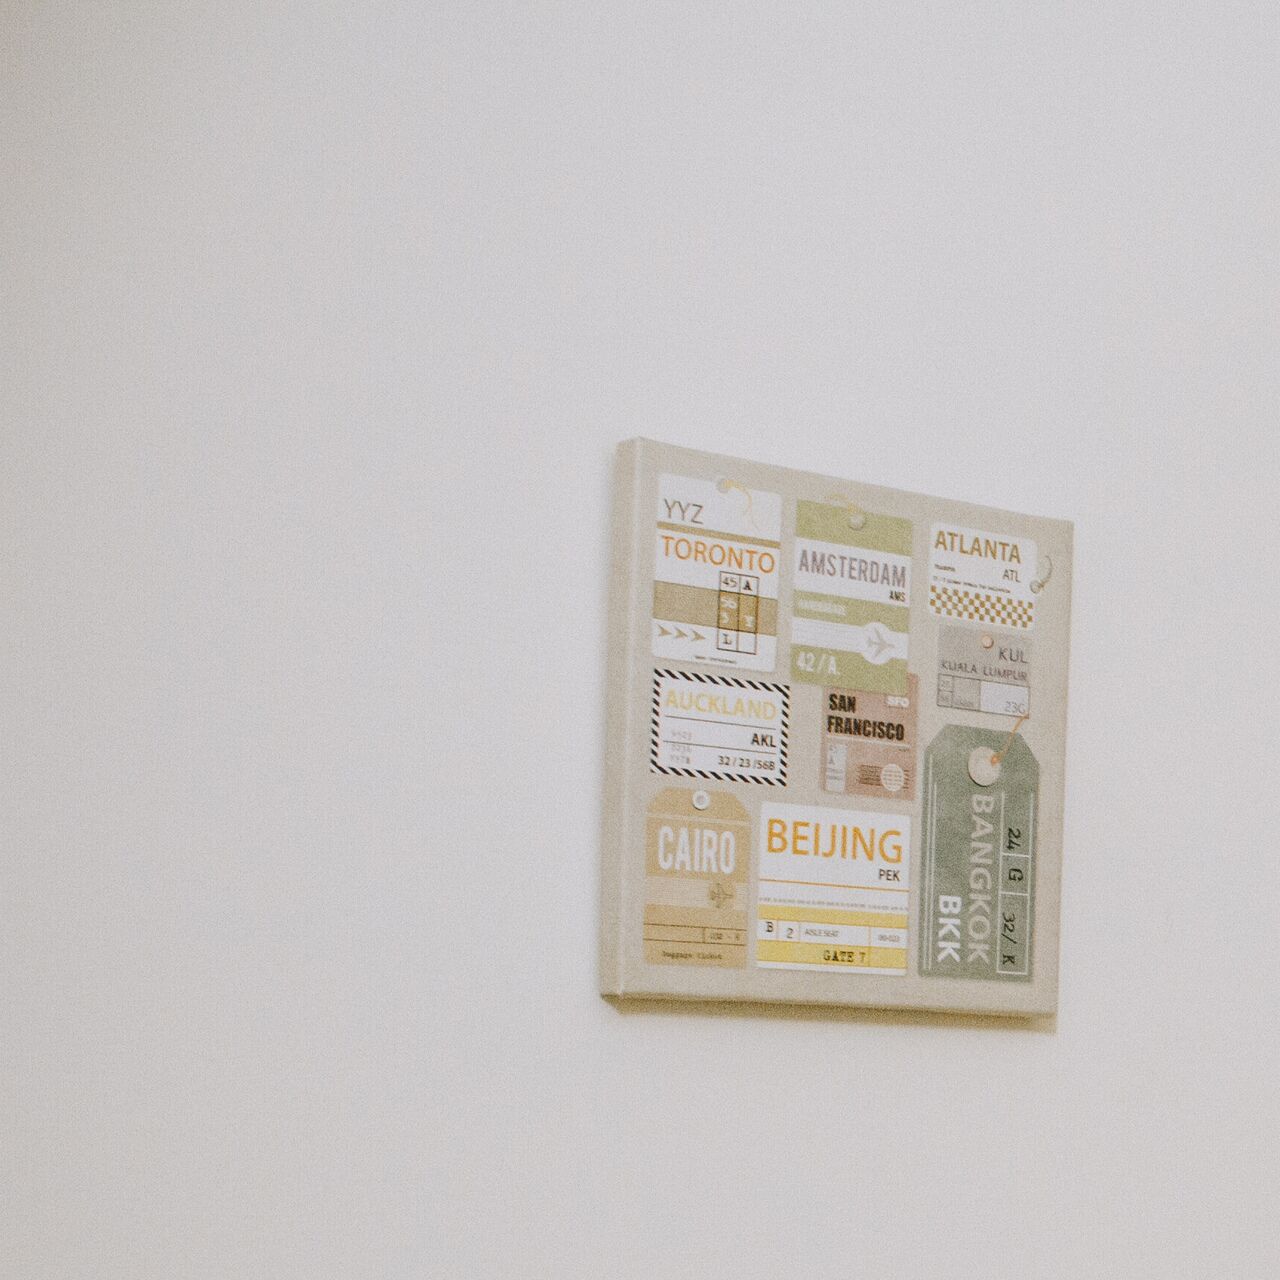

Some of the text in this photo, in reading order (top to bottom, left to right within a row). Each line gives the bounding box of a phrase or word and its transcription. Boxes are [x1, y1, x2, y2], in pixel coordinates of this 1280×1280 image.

[664, 498, 703, 524] YYZ
[661, 535, 775, 573] TORONTO
[934, 530, 1021, 564] ATLANTA
[798, 549, 906, 589] AMSTERDAM
[1002, 569, 1021, 583] ATL
[743, 580, 753, 591] A
[889, 590, 905, 602] AMS
[998, 647, 1028, 664] KUL
[940, 659, 1027, 681] KUALA LUMPUR
[666, 688, 777, 720] AUCKLAND
[829, 693, 856, 714] SAN
[827, 715, 905, 741] FRANCISCO
[751, 733, 776, 748] AKL
[658, 825, 736, 875] CAIRO
[767, 817, 902, 864] BEIJING
[1007, 828, 1021, 851] 24
[878, 868, 901, 882] PEK
[967, 793, 995, 965] BANGKOK
[1008, 868, 1024, 882] G
[765, 921, 774, 933] B
[786, 927, 794, 939] 2
[937, 895, 962, 963] BKK
[823, 950, 855, 963] GATE
